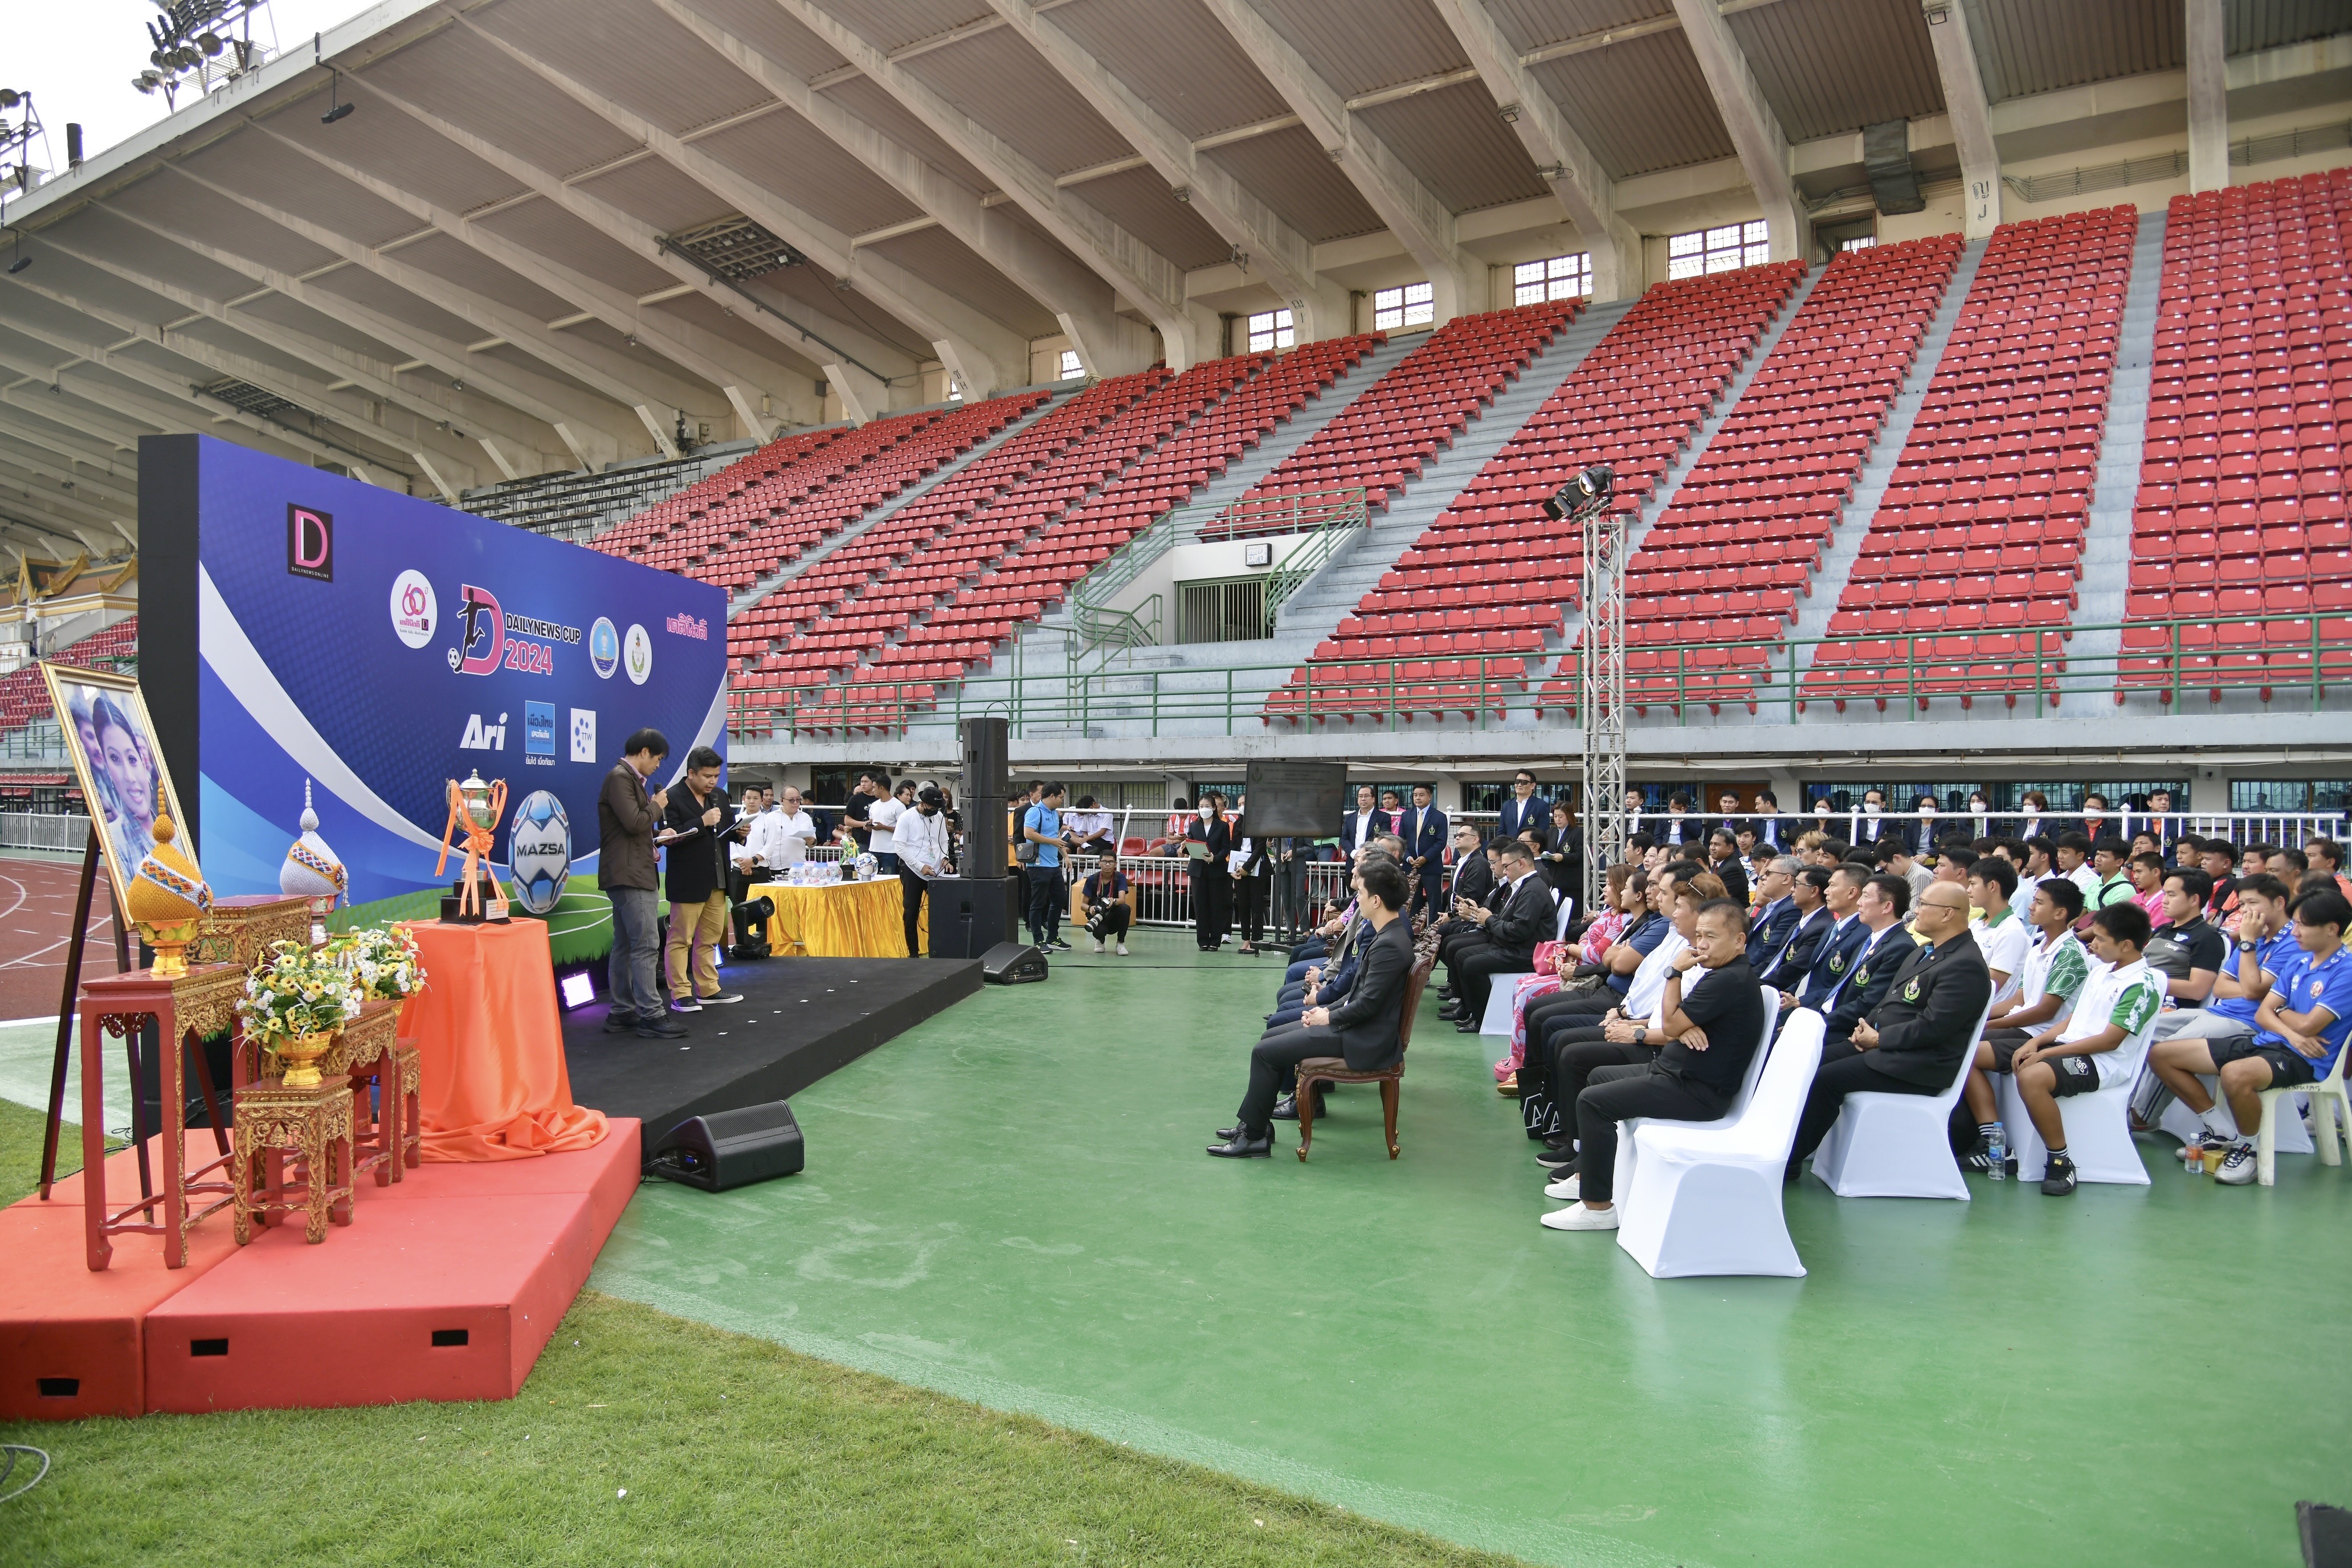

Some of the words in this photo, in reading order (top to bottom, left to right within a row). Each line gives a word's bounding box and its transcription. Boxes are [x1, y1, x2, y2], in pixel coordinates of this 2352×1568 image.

[295, 509, 328, 567] D
[402, 583, 426, 616] 60
[506, 612, 561, 641] DAILYNEWS
[562, 625, 581, 644] CUP
[667, 612, 708, 640] เดลินิวส์
[505, 638, 553, 675] 2024
[459, 712, 508, 751] Ari
[528, 713, 553, 728] เมืองไทย
[581, 732, 593, 741] TTW
[516, 842, 566, 858] MAZSA
[2164, 942, 2179, 951] Chang
